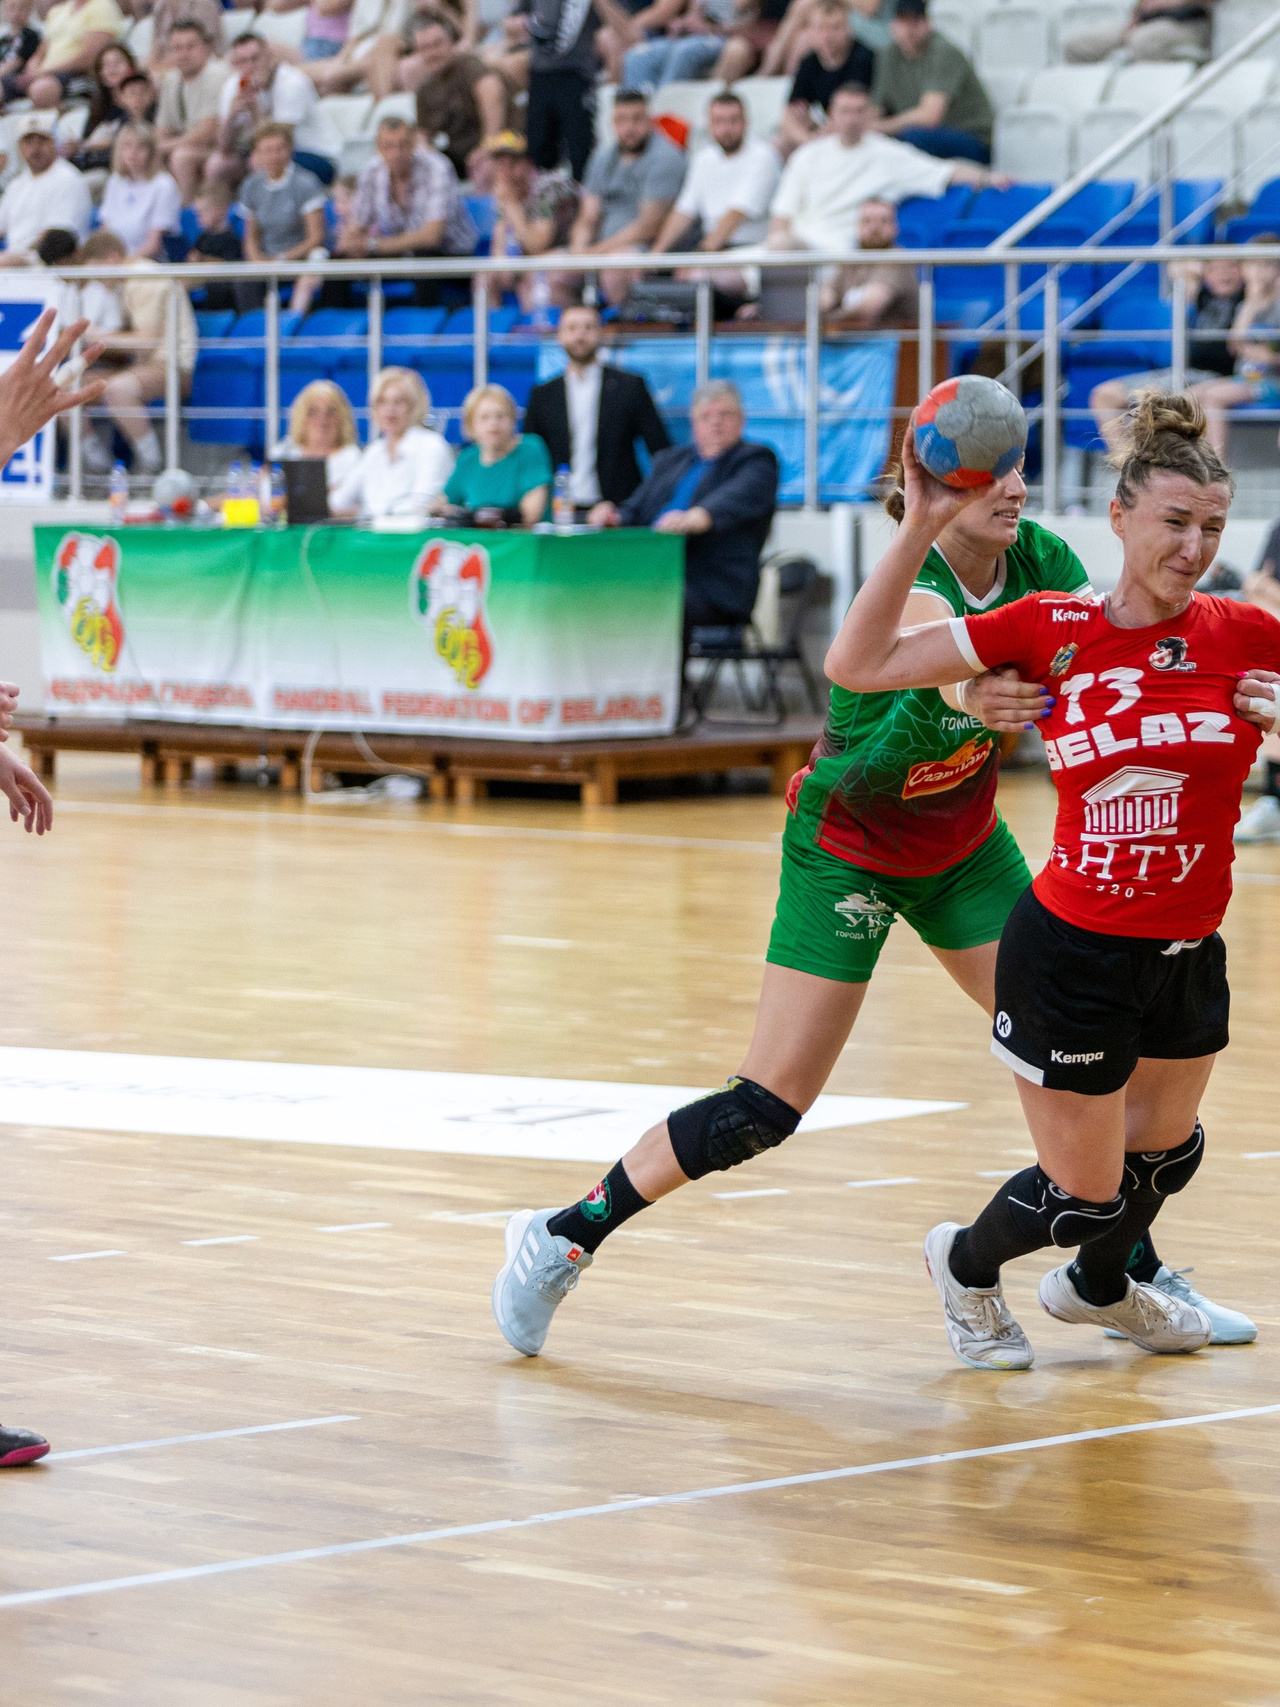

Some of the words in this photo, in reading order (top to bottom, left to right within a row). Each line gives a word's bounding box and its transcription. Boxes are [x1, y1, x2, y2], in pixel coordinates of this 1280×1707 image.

[517, 697, 549, 724] OF
[560, 695, 664, 723] BELARUS
[1044, 711, 1236, 771] BELAZ
[835, 930, 865, 941] ГОРОДА
[1051, 1050, 1104, 1065] Kempa
